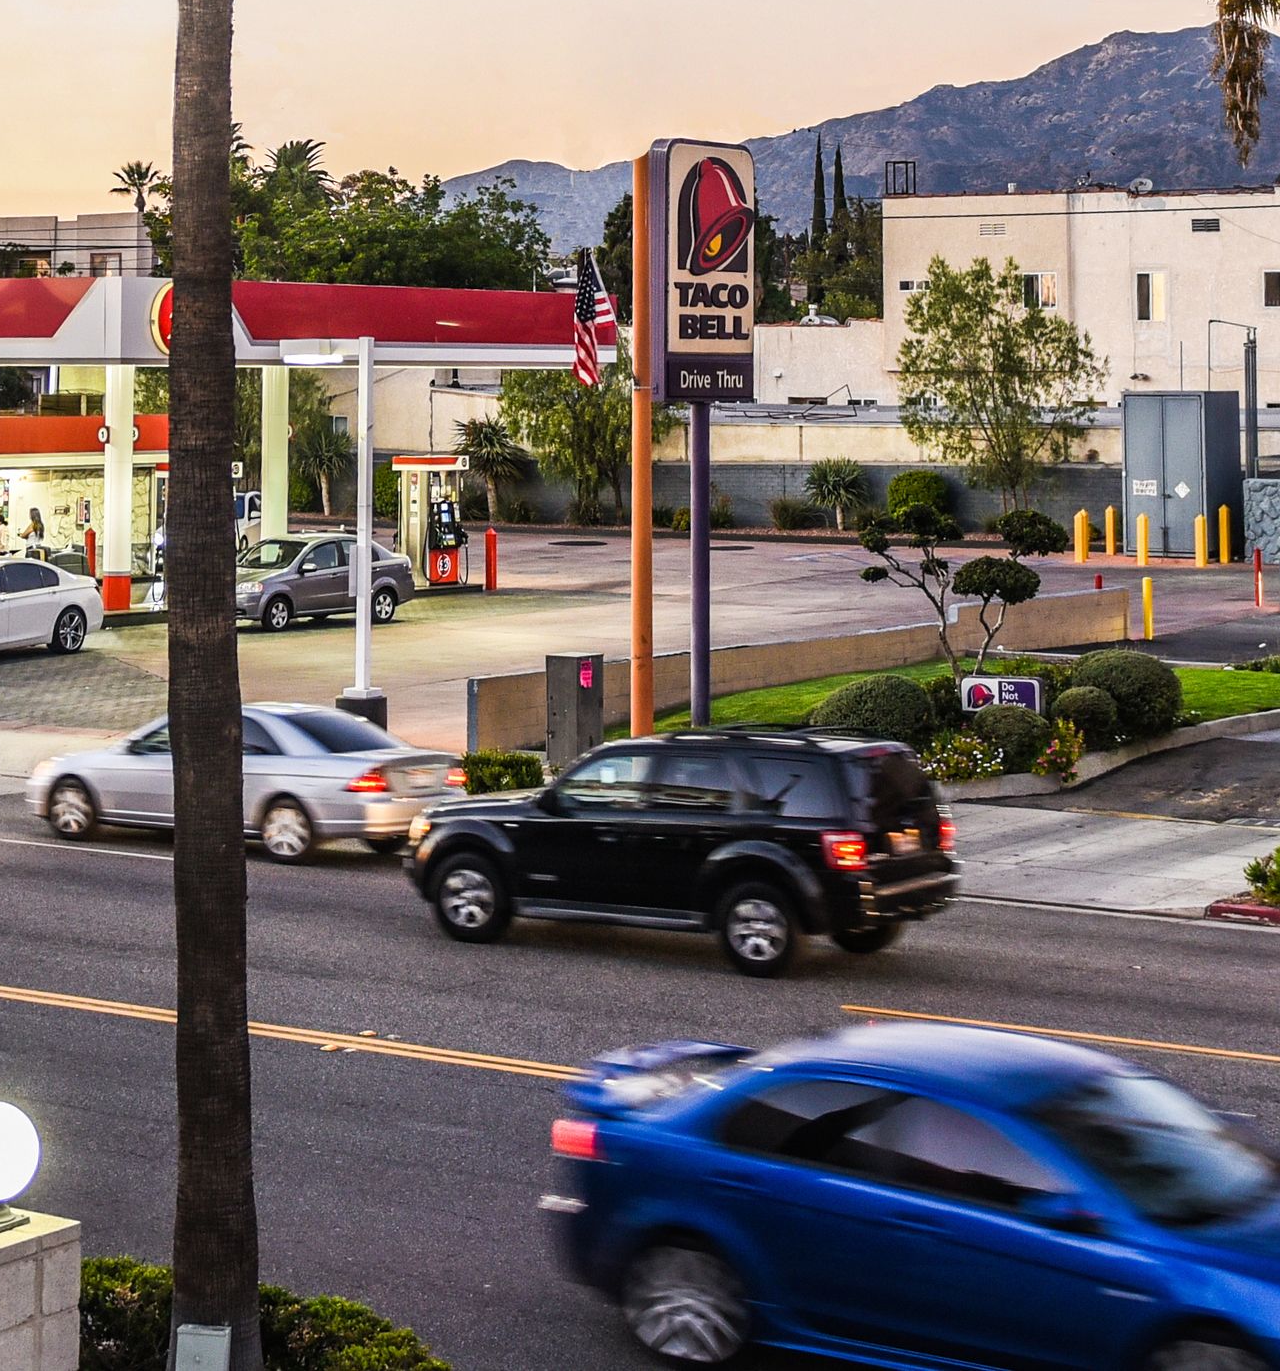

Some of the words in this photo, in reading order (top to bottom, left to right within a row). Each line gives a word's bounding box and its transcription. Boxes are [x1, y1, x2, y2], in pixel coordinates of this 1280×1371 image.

[674, 282, 749, 309] TACO
[679, 314, 749, 340] BELL
[680, 369, 711, 389] Drive
[716, 370, 744, 388] Thru
[1002, 692, 1018, 700] Not
